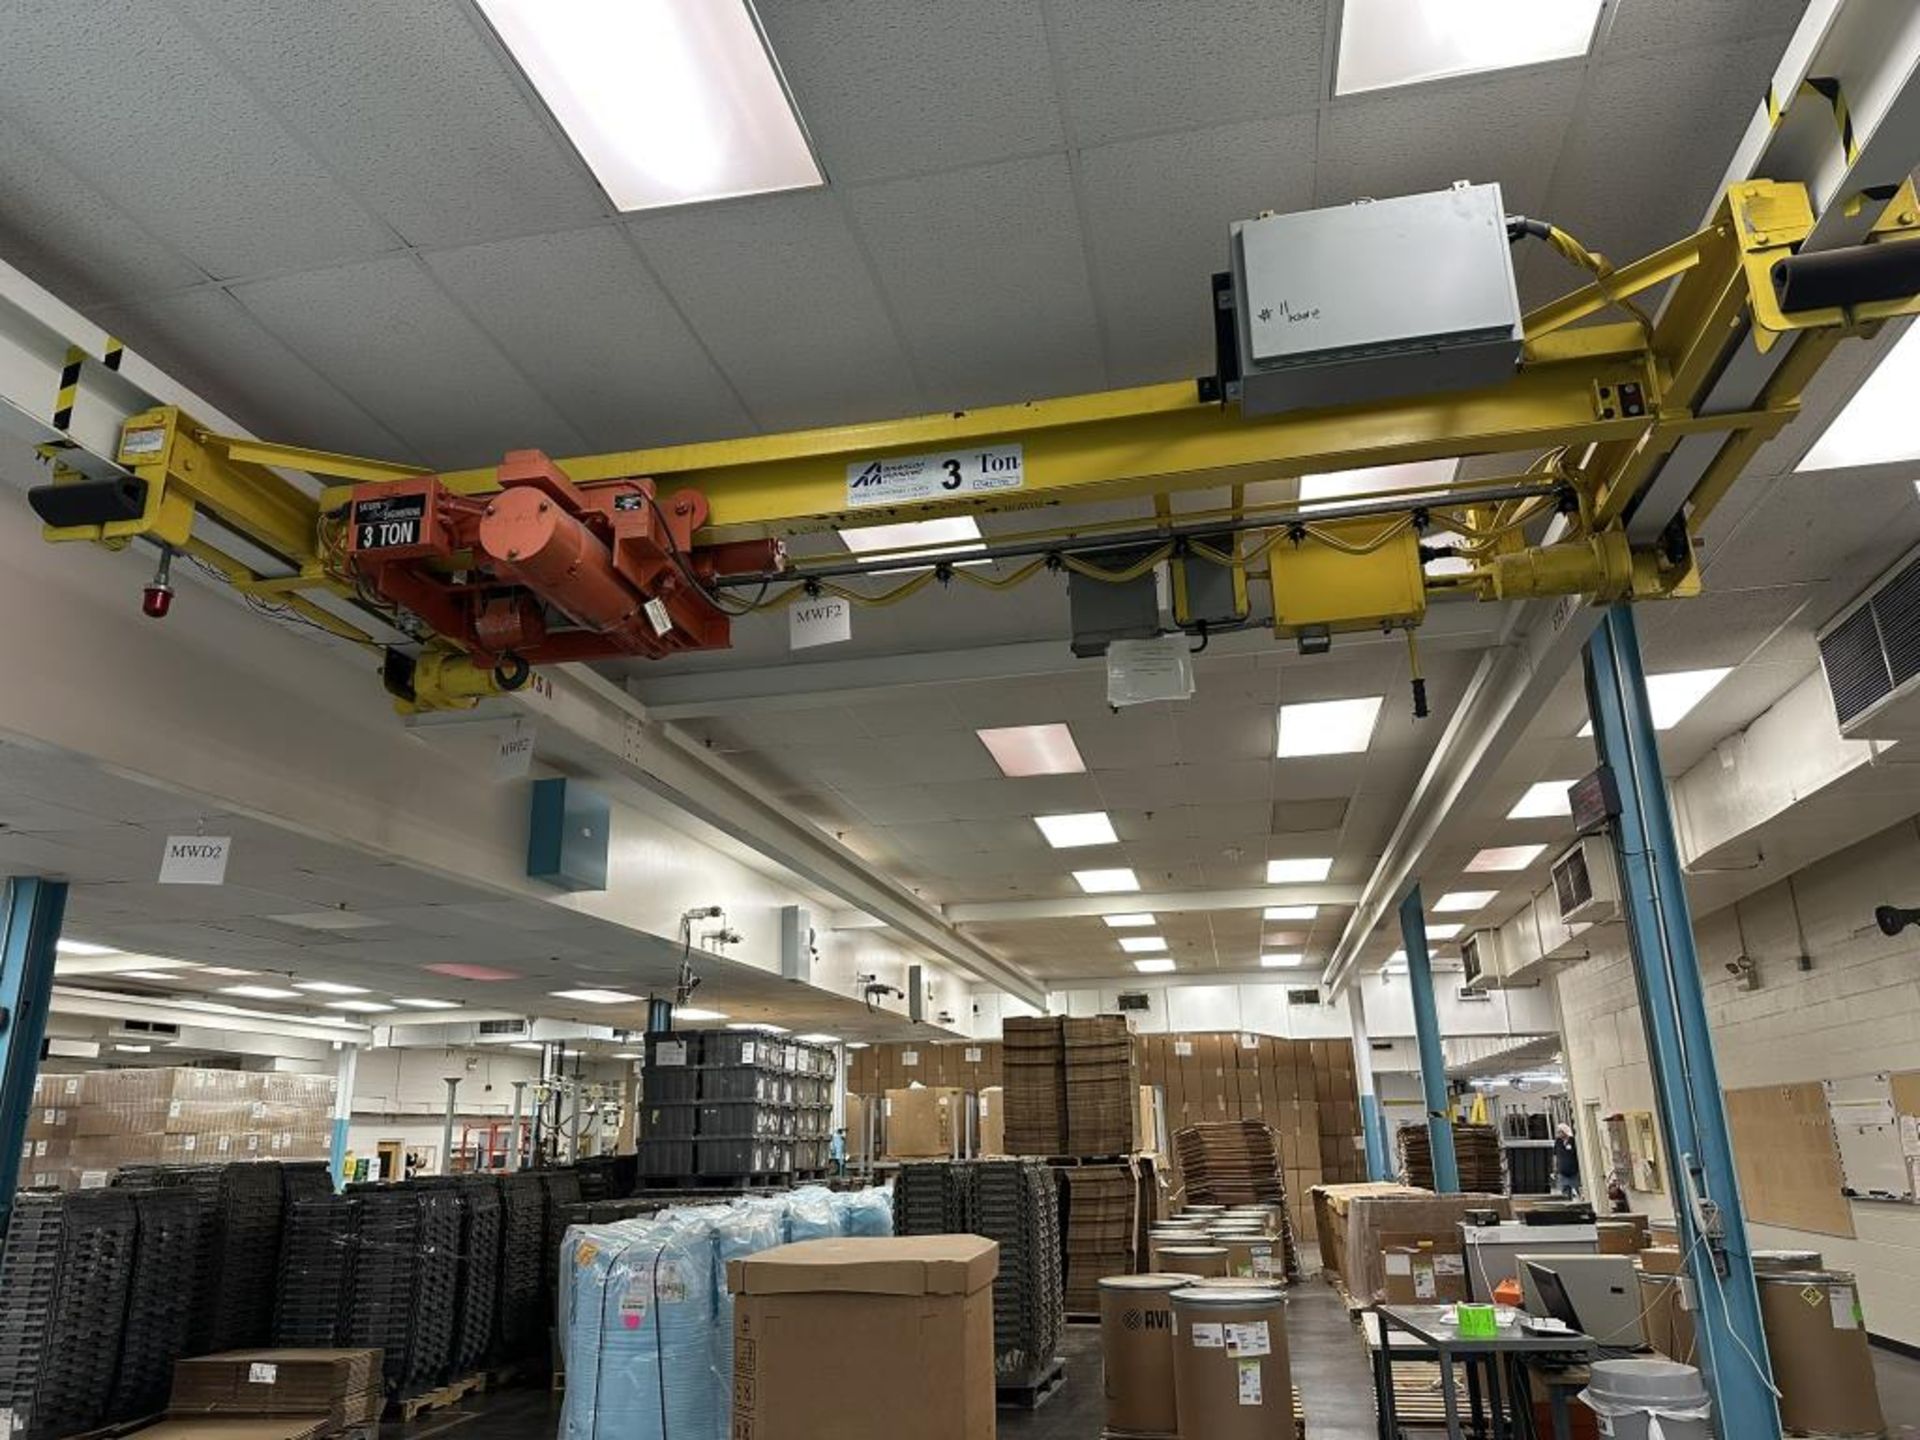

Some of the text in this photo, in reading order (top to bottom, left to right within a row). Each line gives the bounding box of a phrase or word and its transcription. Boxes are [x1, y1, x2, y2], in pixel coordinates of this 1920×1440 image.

[941, 458, 963, 490] 3
[974, 452, 1019, 474] Ton
[363, 521, 414, 548] 3 TON
[796, 604, 843, 623] MWF2
[170, 845, 222, 859] MWD2
[1145, 1310, 1169, 1329] AVI
